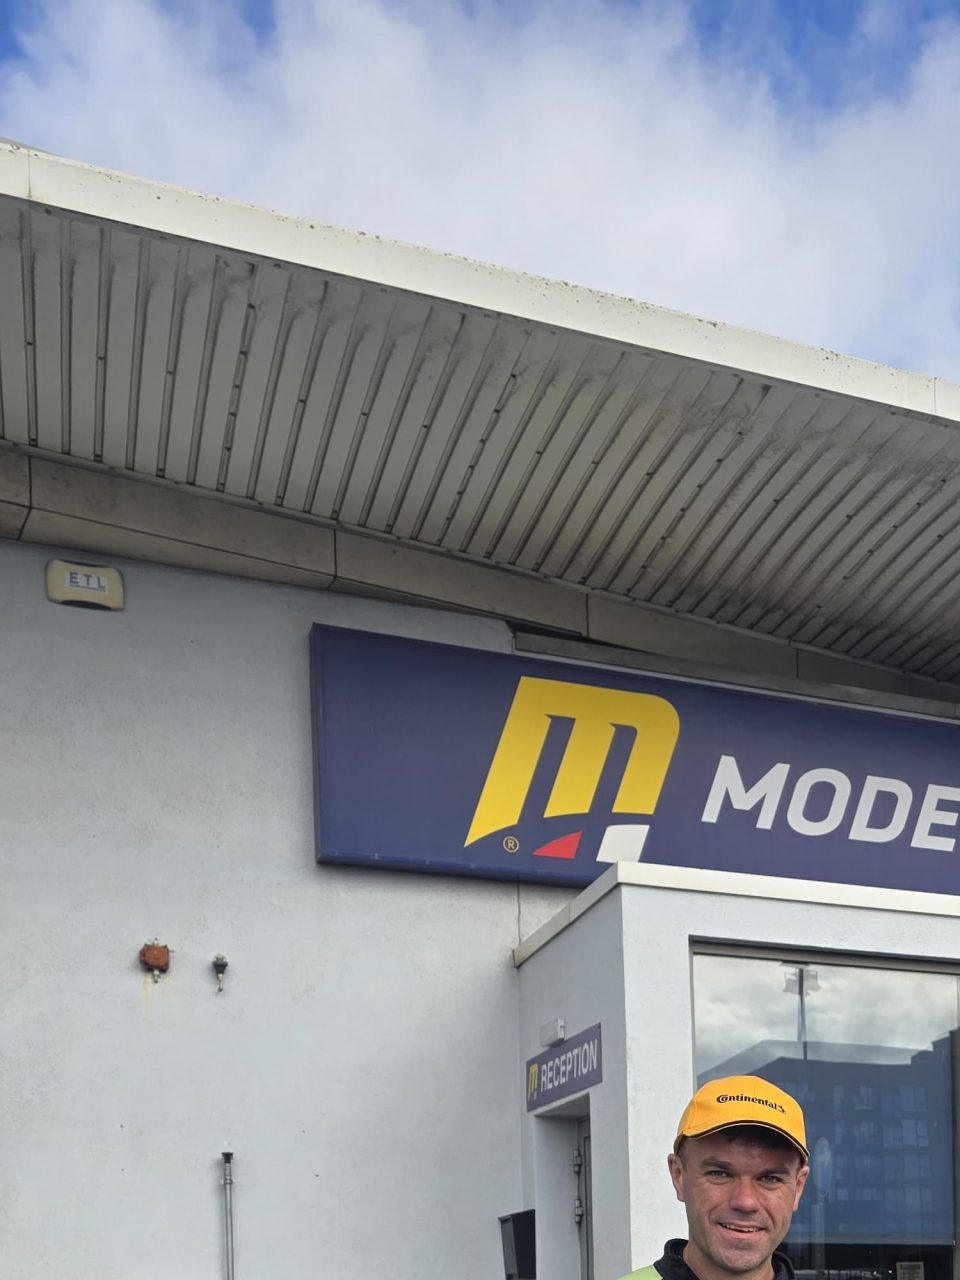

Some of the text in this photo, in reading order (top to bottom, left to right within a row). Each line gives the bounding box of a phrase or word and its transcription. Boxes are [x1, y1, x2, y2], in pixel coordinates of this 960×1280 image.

[69, 571, 107, 590] ETL
[540, 1038, 598, 1093] RECEPTION
[716, 1094, 778, 1110] Continental
